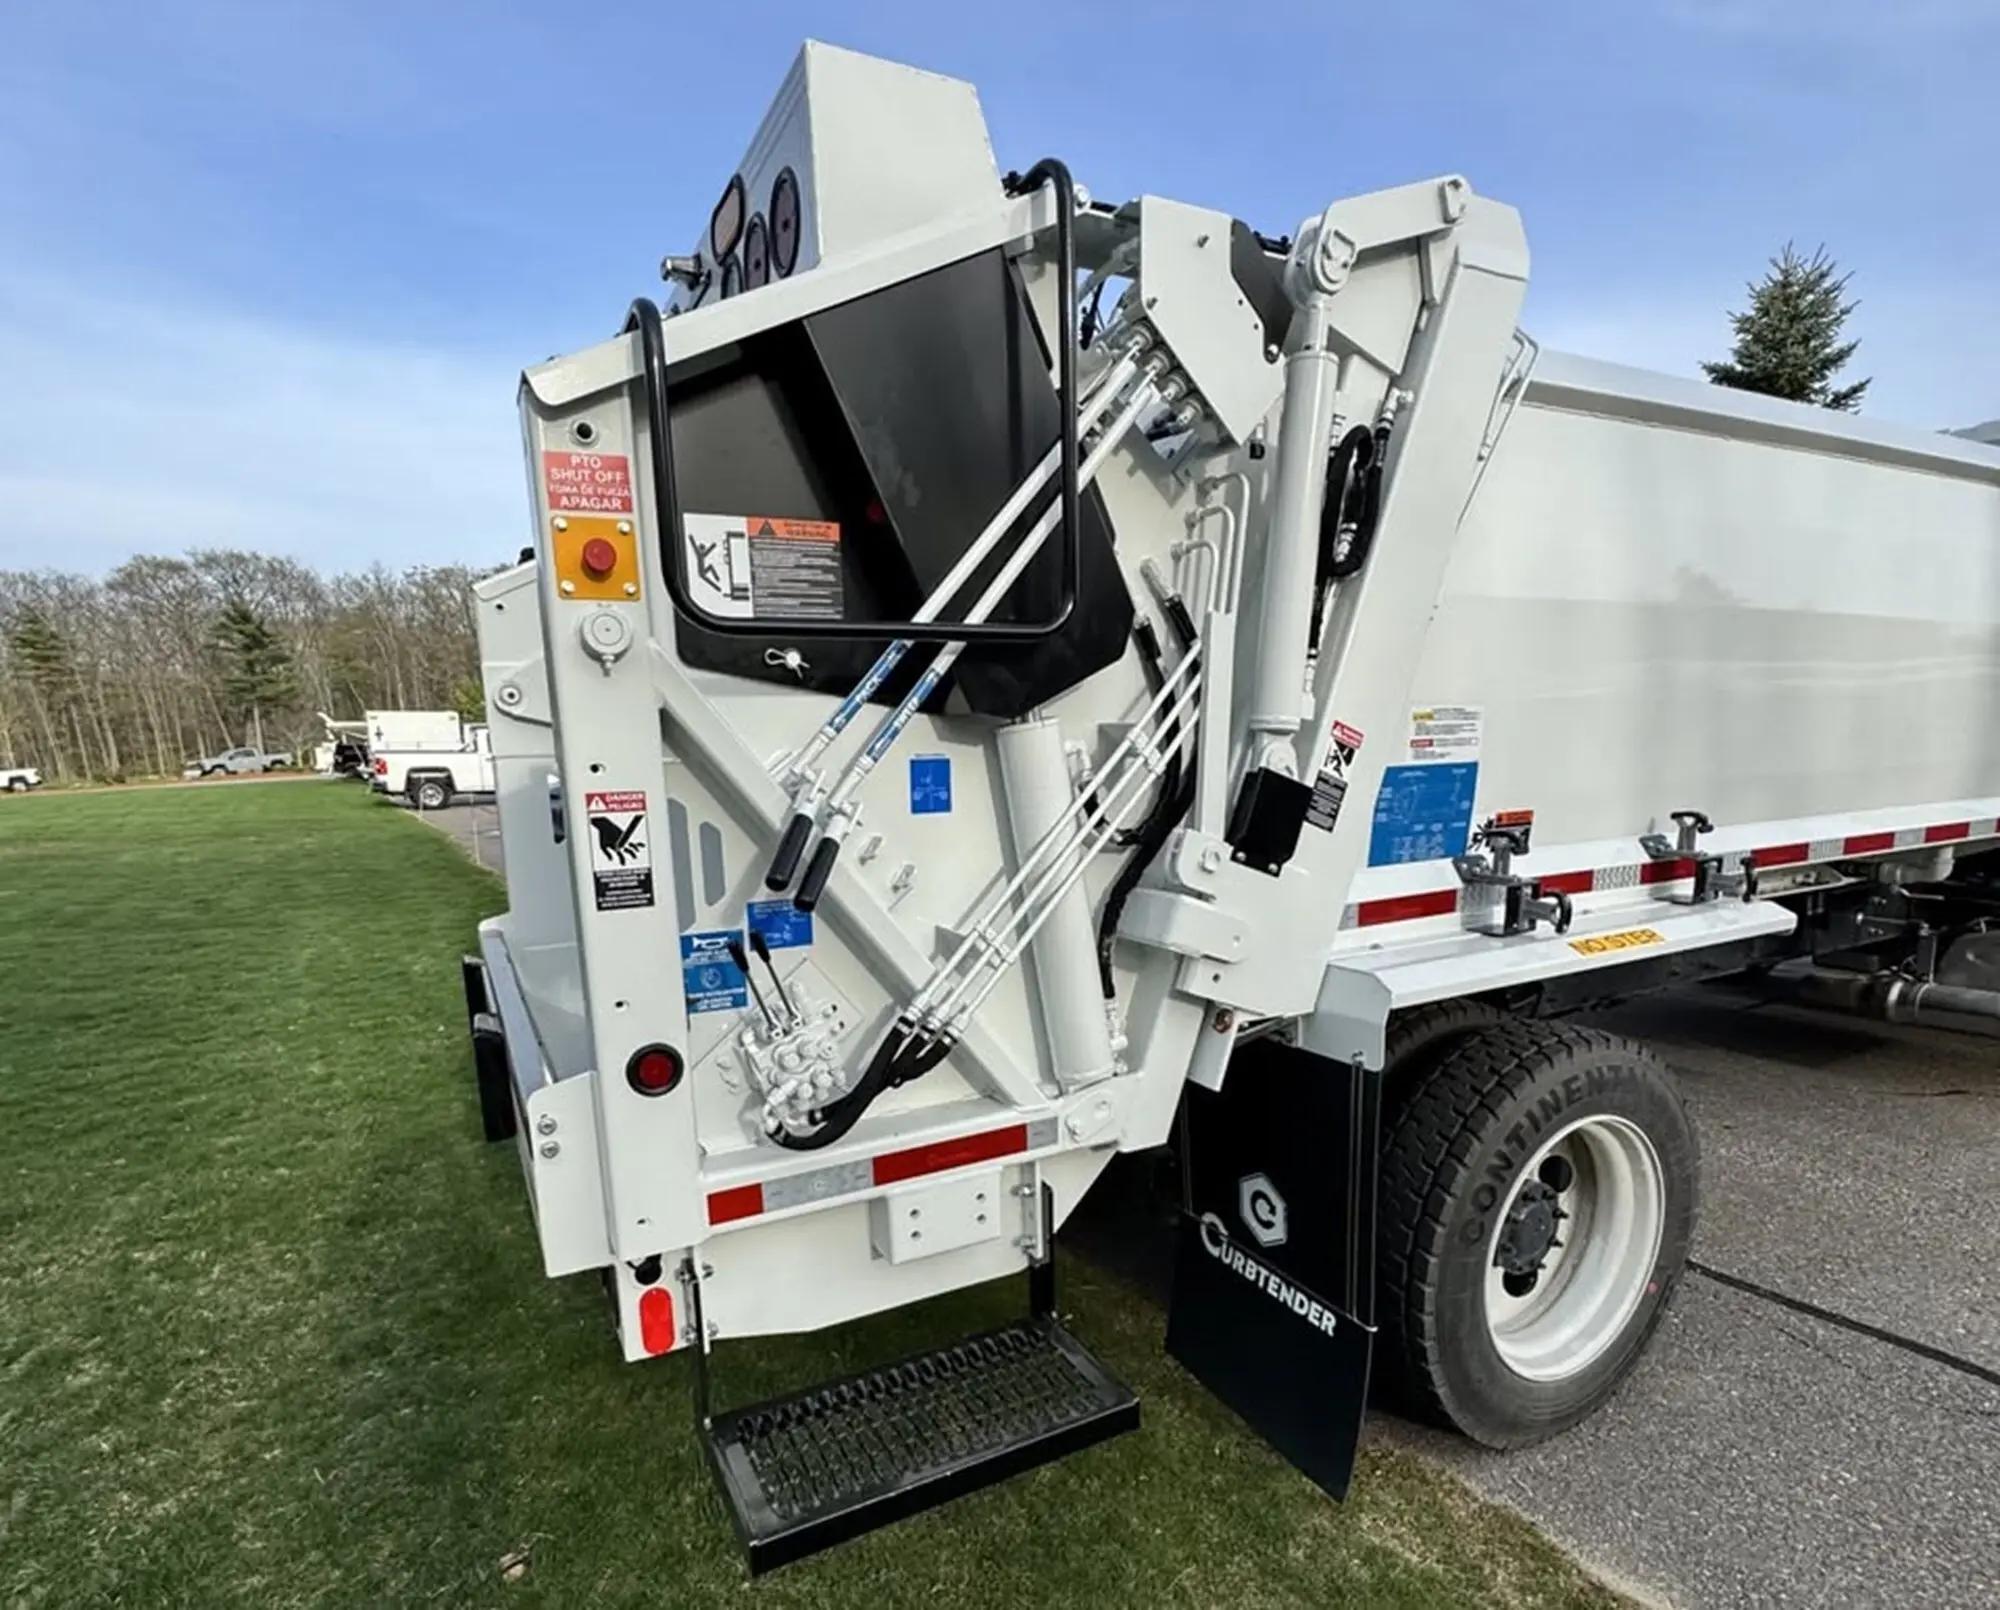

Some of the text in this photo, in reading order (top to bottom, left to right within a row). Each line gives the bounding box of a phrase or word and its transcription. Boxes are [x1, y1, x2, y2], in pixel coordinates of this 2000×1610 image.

[570, 455, 602, 469] PTO
[551, 467, 625, 484] SHUT OFF
[560, 495, 623, 510] APAGAR
[605, 792, 644, 803] DANGER
[1569, 927, 1657, 955] NO STEP
[1200, 1211, 1337, 1337] CURBTENDER
